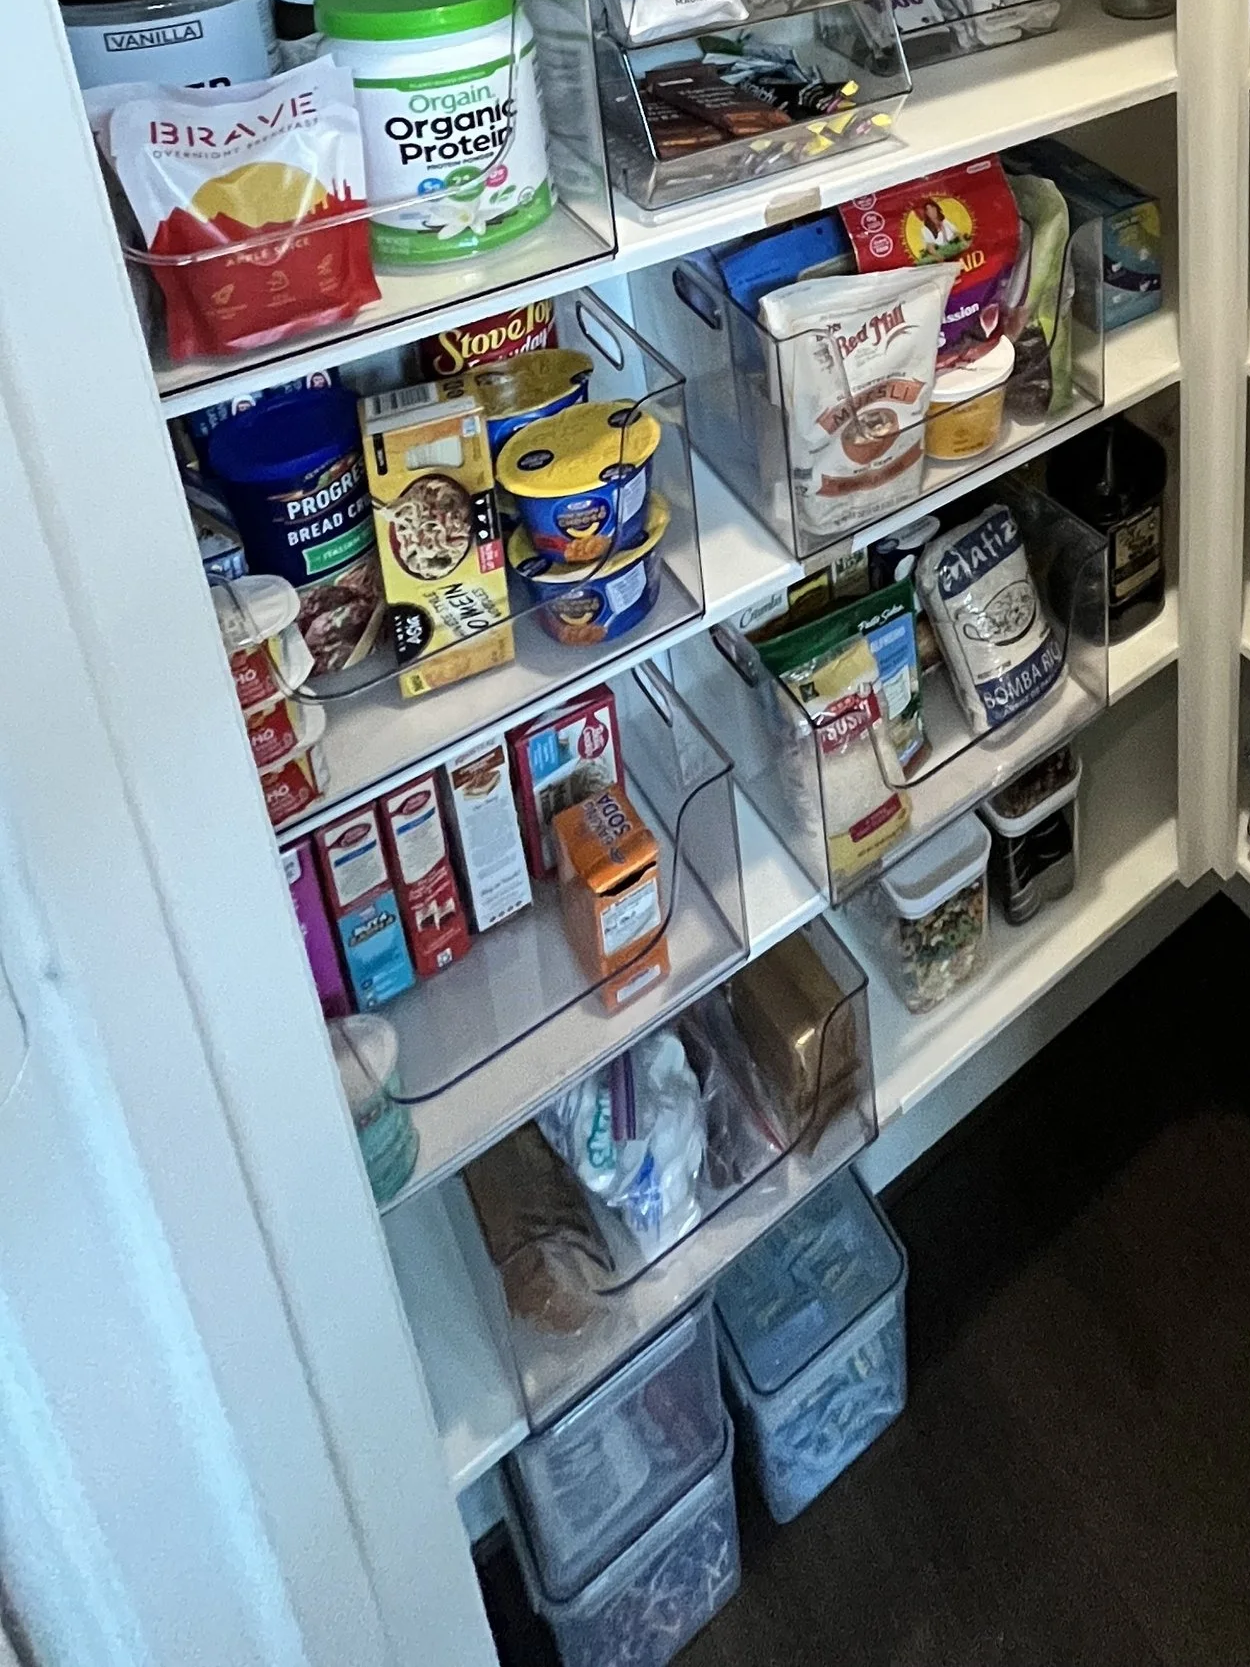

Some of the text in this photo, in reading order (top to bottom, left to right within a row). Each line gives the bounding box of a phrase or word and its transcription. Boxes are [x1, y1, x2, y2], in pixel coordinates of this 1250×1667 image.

[110, 25, 198, 50] VANILLA
[150, 91, 317, 147] BRAVE
[384, 97, 518, 141] Organic
[408, 84, 492, 114] Orgain
[153, 146, 241, 160] OVERNIGHT
[399, 124, 513, 165] Protein
[433, 320, 526, 376] Stove
[837, 325, 868, 359] Red
[868, 304, 907, 346] Mill
[286, 454, 366, 521] PROGRE
[287, 513, 343, 547] BREAD
[439, 582, 485, 621] MEIN
[983, 663, 1043, 710] BOMBA
[598, 793, 632, 836] SODA
